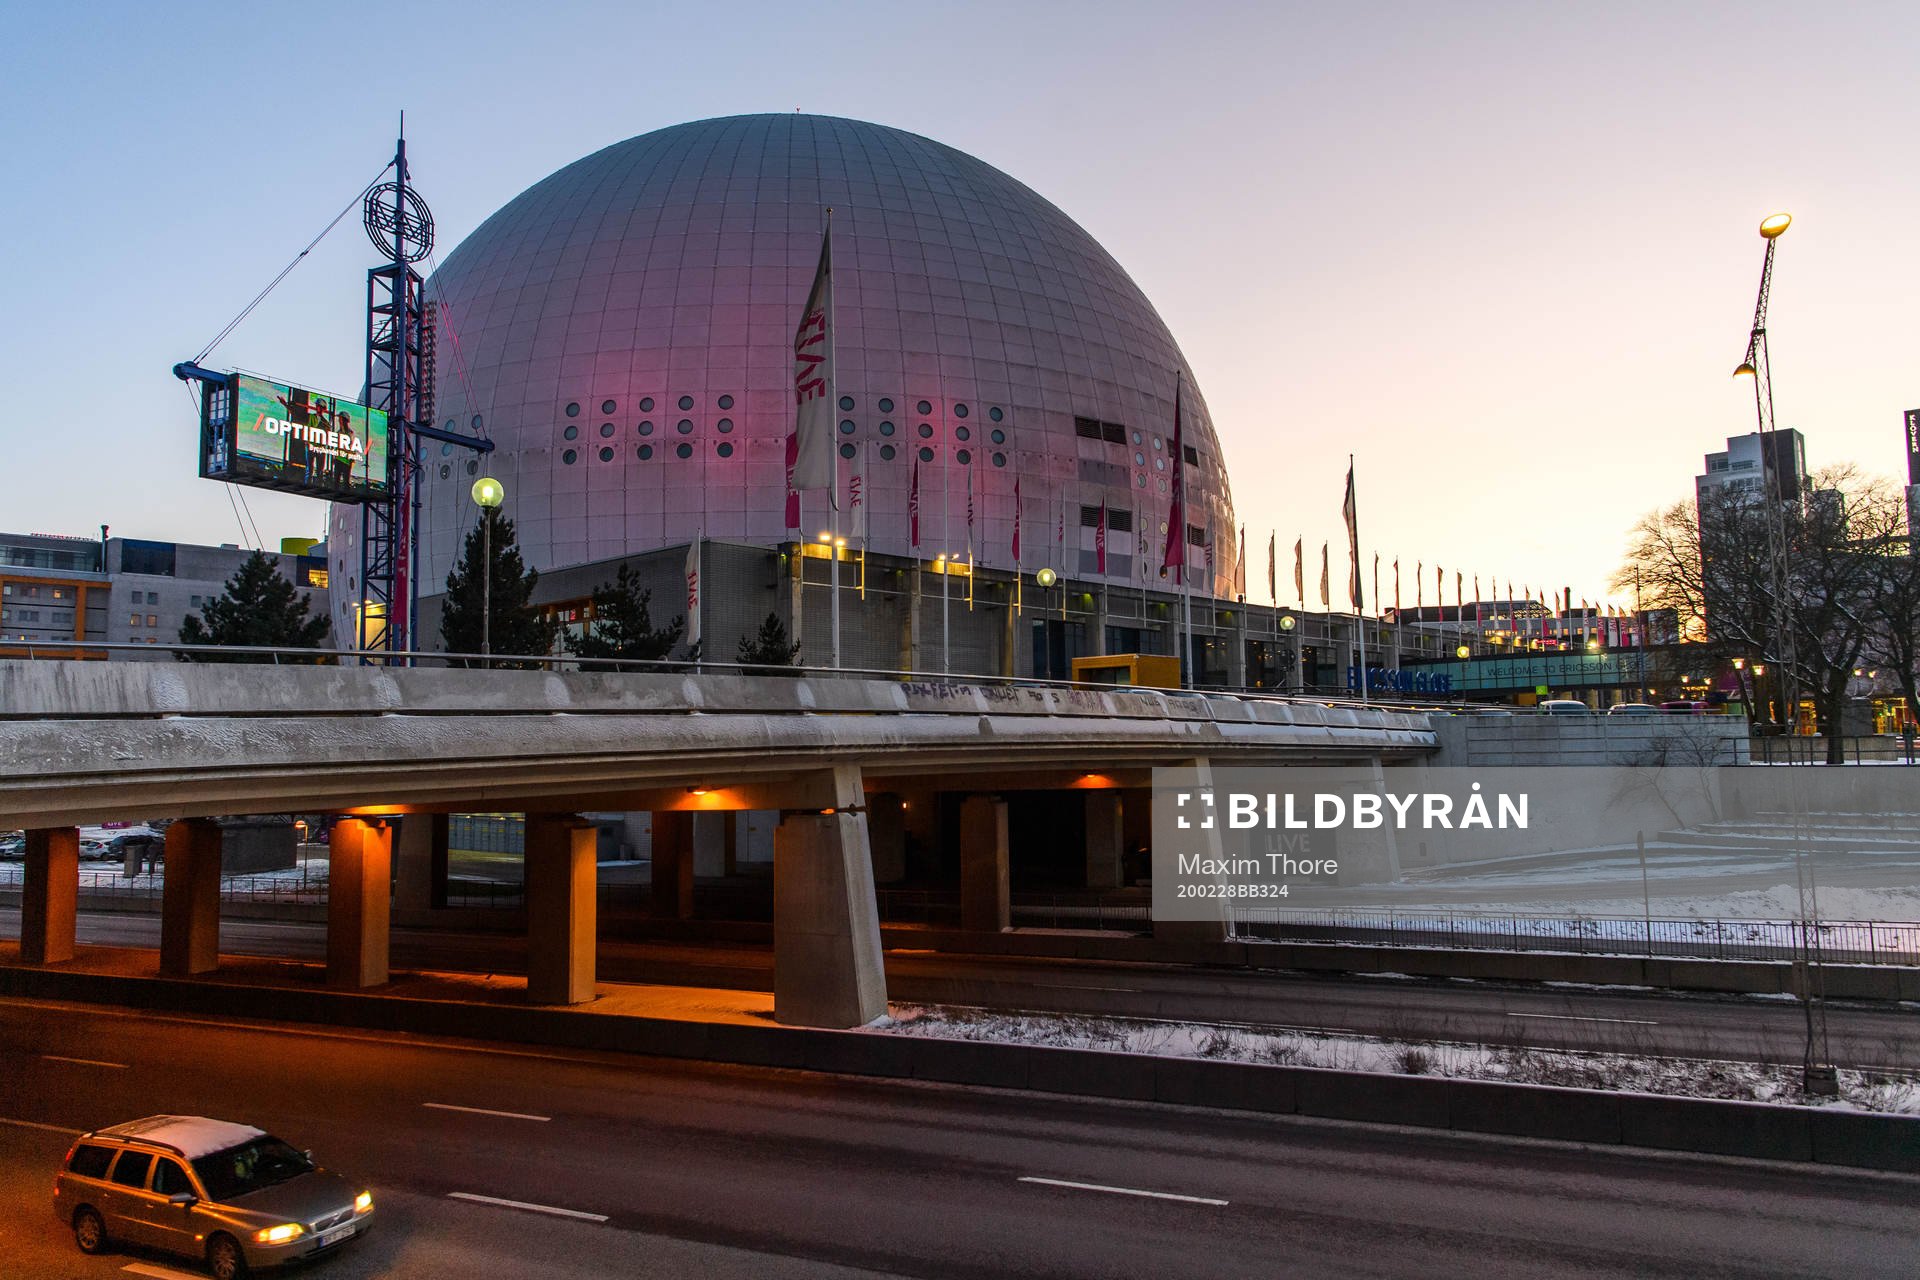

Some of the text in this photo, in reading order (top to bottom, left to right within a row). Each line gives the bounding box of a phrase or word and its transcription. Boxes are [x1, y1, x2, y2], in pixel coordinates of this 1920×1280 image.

[265, 417, 363, 453] OPTIMERA
[1487, 665, 1538, 676] WELCOME
[1559, 662, 1612, 672] ERICSSON
